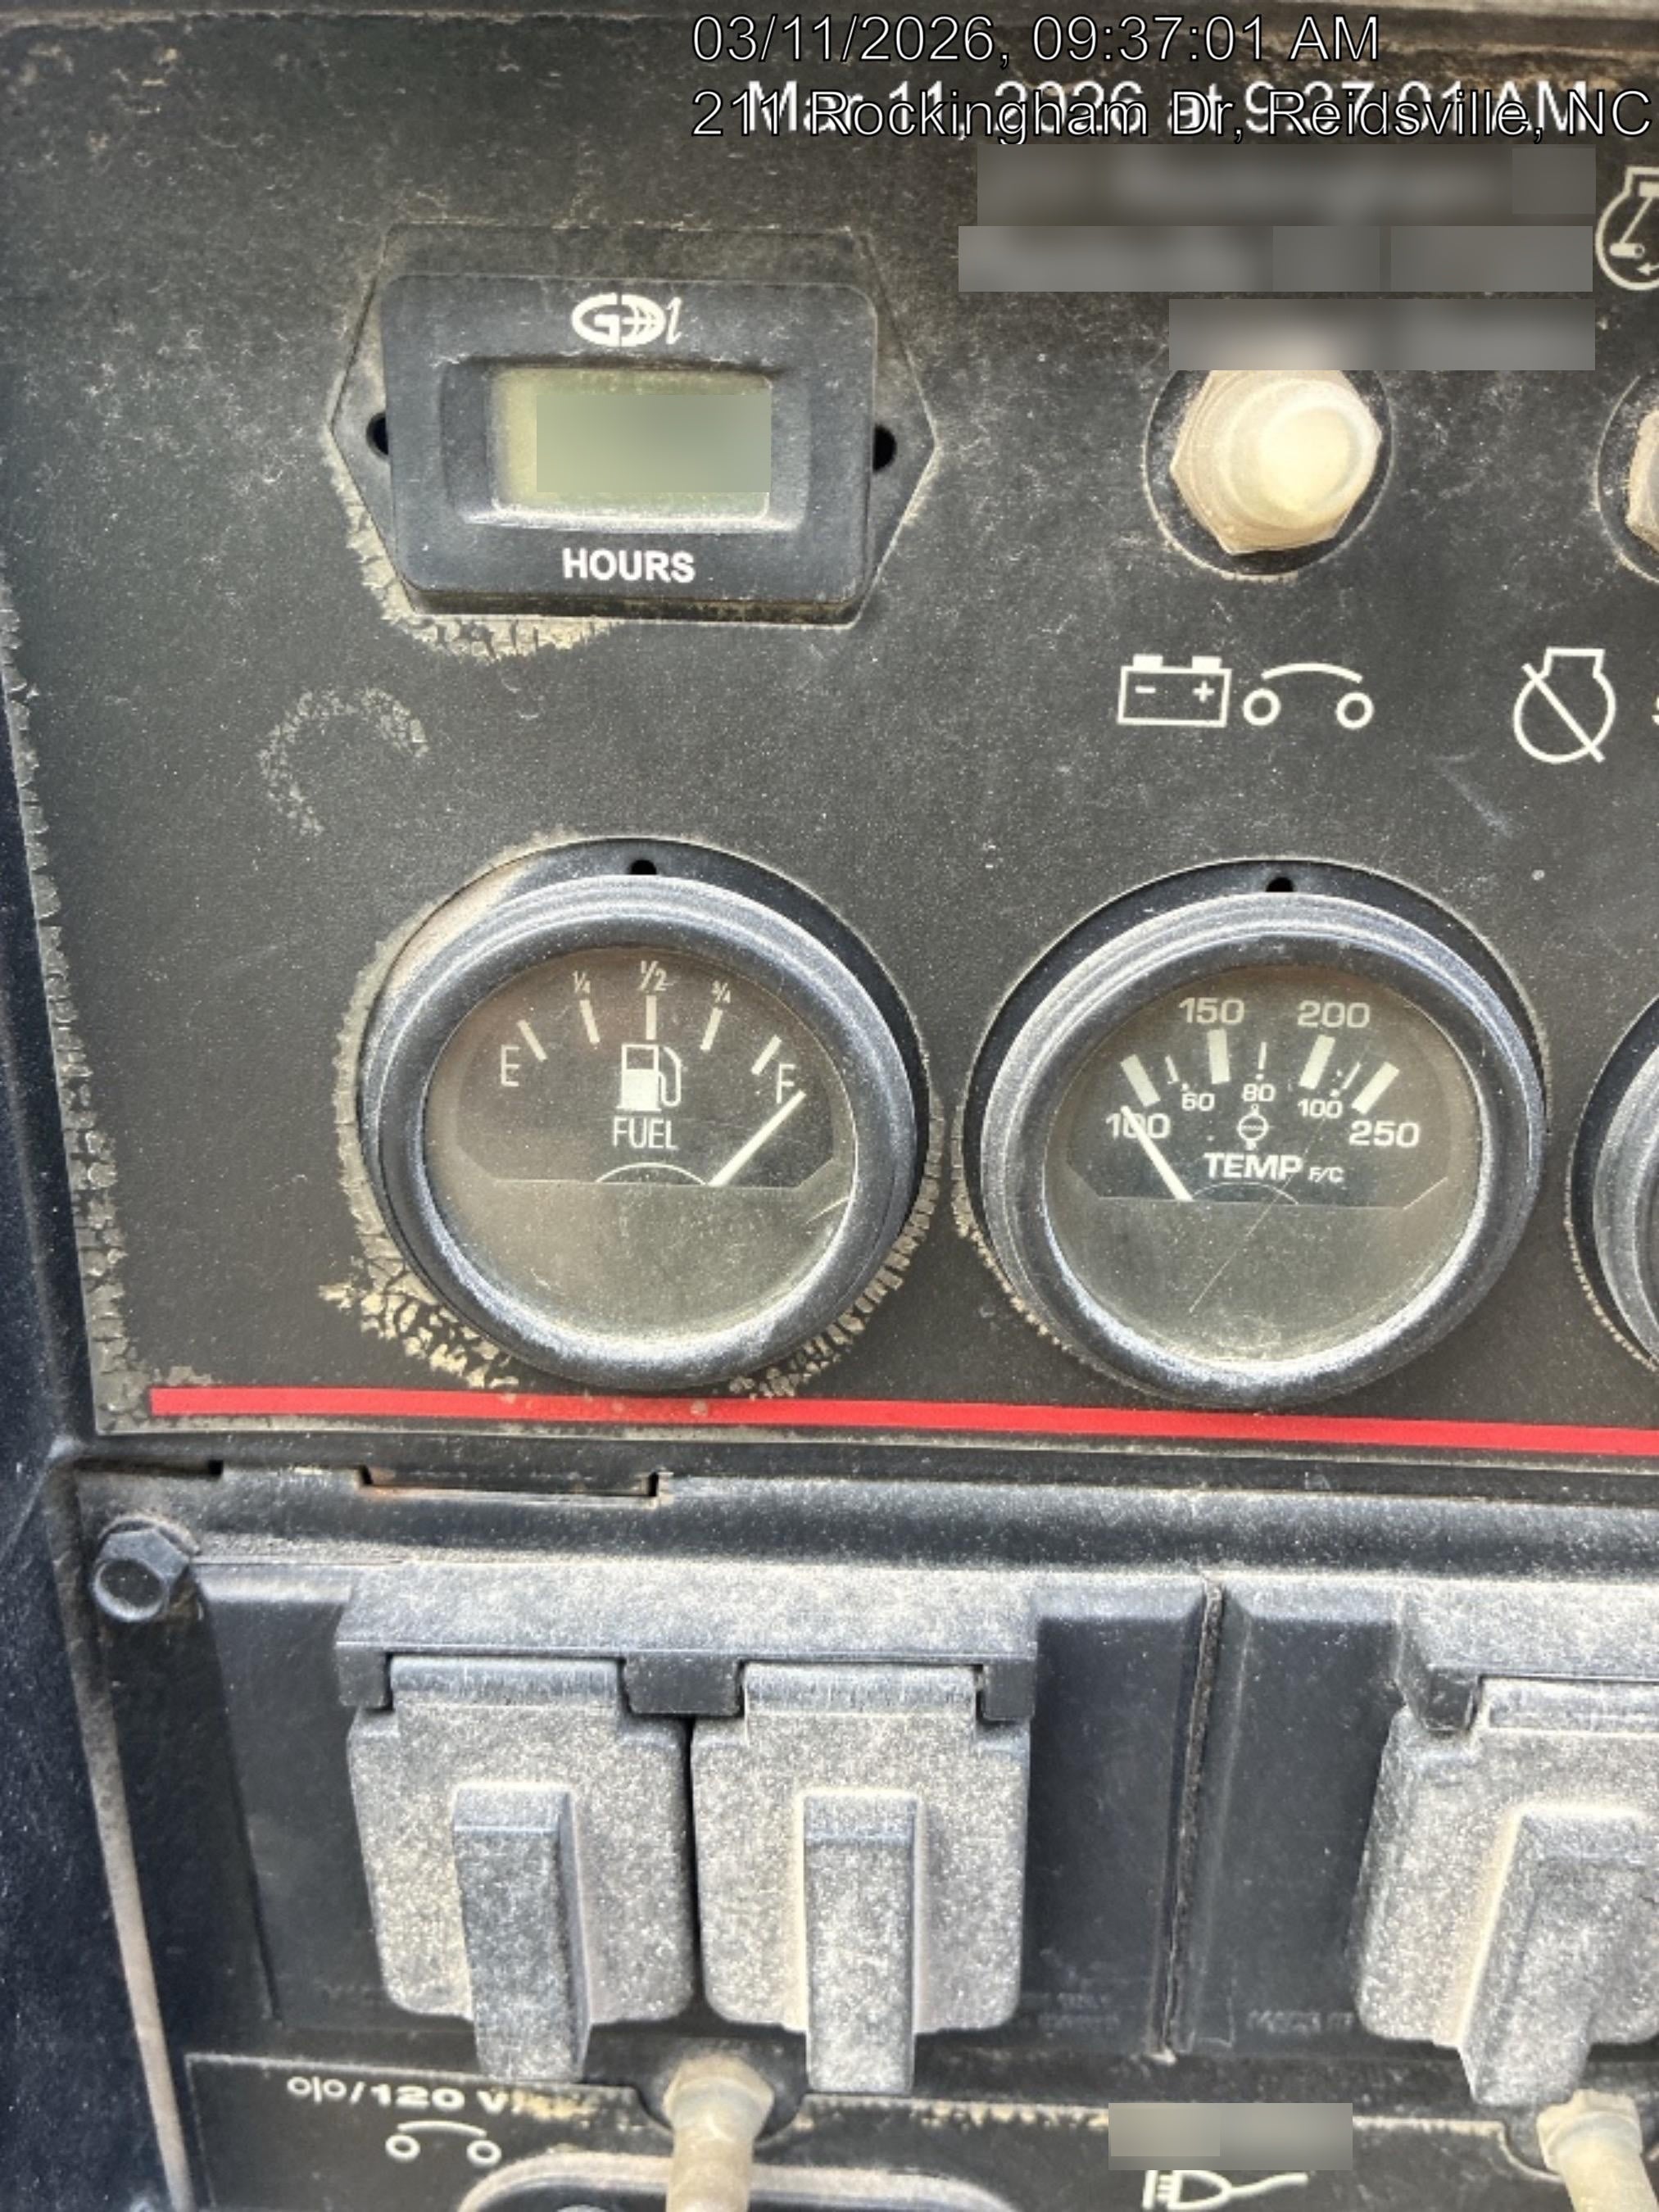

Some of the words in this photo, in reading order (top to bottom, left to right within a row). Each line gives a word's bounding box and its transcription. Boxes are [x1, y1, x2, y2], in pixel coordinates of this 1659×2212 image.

[562, 548, 696, 583] HOURS
[1177, 997, 1245, 1026] 150
[1297, 1001, 1371, 1029] 200
[500, 1045, 521, 1087] E
[775, 1063, 796, 1104] F
[1241, 1084, 1276, 1103] 80
[1181, 1093, 1215, 1113] 60
[1297, 1098, 1344, 1119] 100
[612, 1117, 678, 1150] FUEL
[1106, 1113, 1172, 1140] 100
[1349, 1119, 1420, 1148] 250
[1203, 1152, 1303, 1181] TEMP
[1308, 1166, 1344, 1184] F/C
